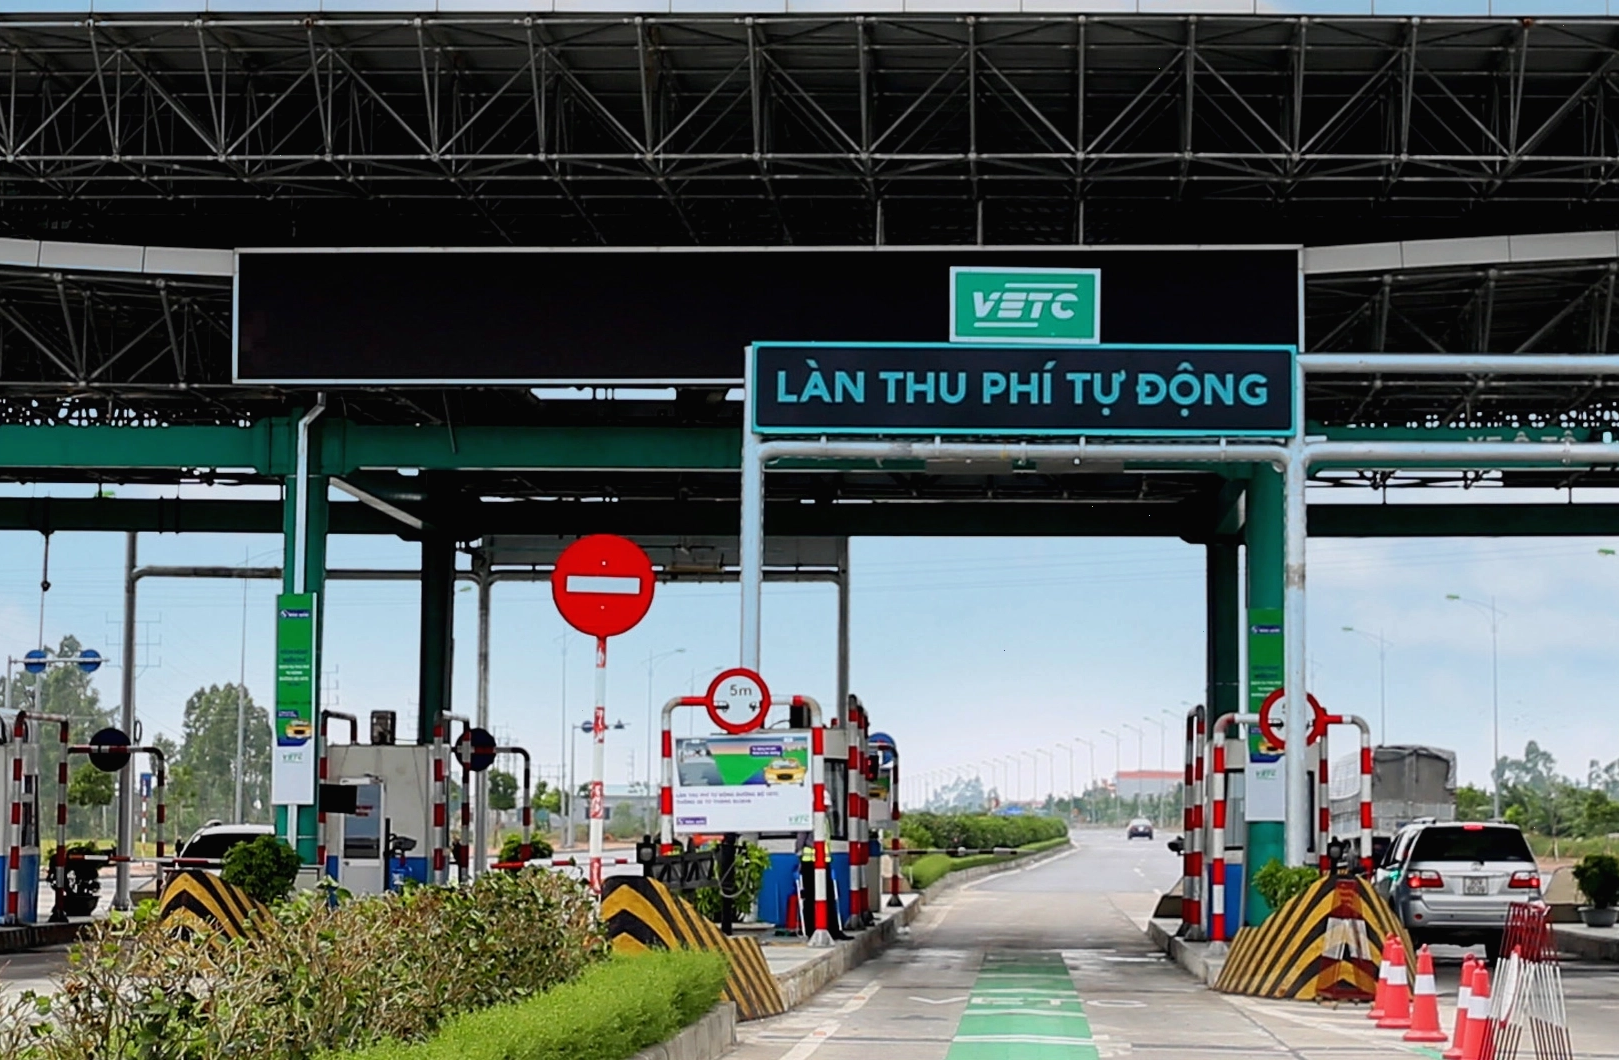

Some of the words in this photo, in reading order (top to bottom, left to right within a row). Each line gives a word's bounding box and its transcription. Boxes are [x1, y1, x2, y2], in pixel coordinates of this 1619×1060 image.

[973, 291, 1079, 319] VETC
[777, 359, 865, 403] LÀN
[879, 371, 967, 404] THU
[982, 360, 1057, 405] PHÍ
[1065, 369, 1127, 416] TỰ
[1136, 361, 1269, 418] ĐỘNG
[729, 684, 753, 697] 5m
